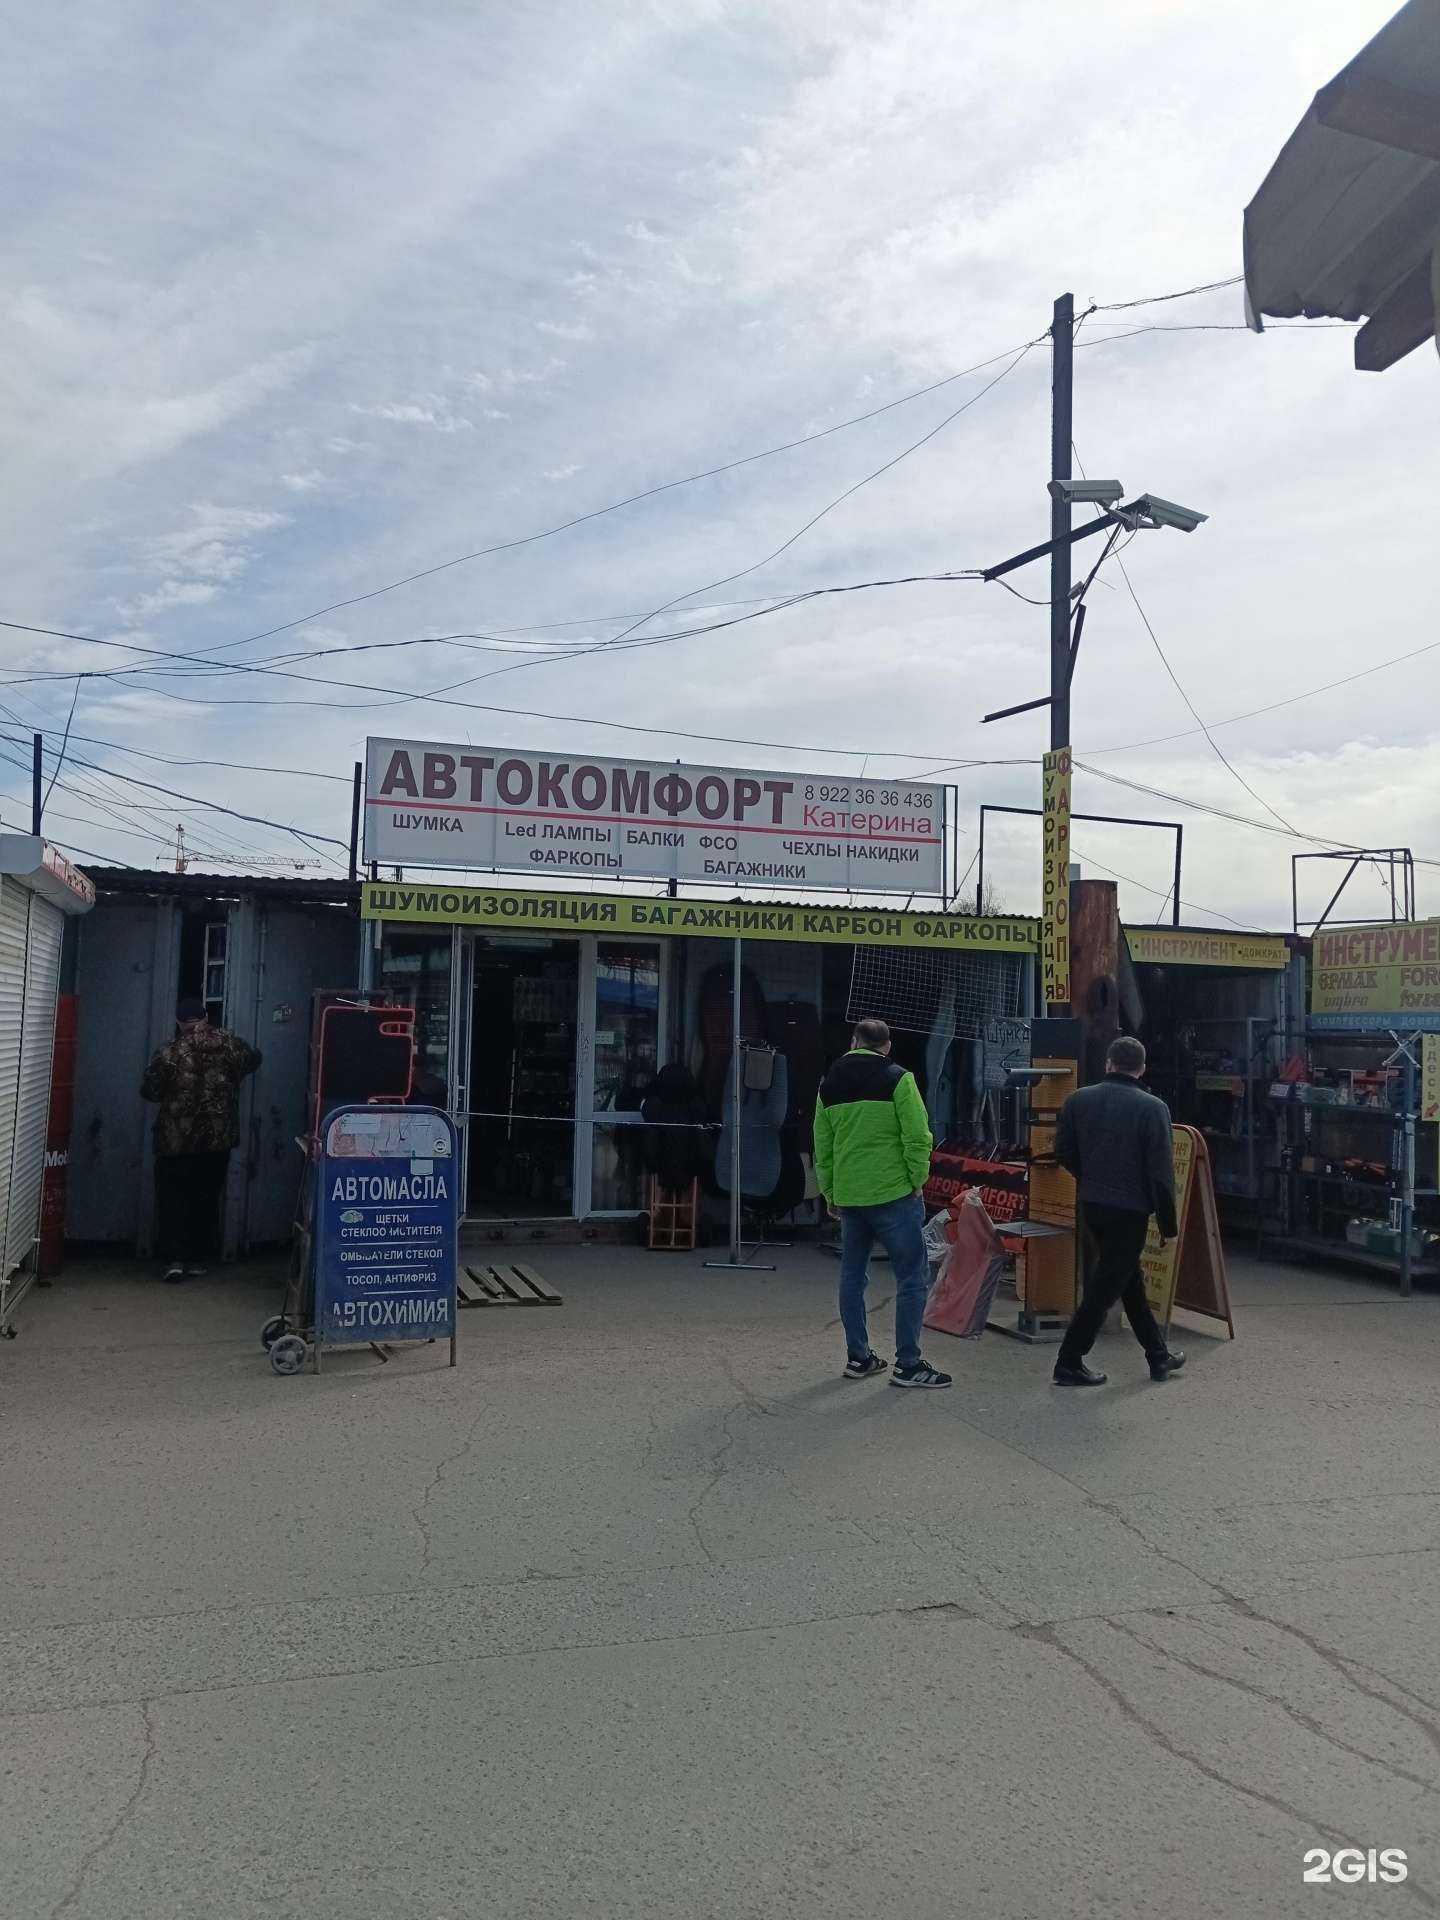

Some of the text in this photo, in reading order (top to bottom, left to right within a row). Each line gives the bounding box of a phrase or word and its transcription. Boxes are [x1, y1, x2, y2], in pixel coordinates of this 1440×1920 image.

[380, 750, 793, 824] АВТОКОМФОРТ
[805, 785, 933, 809] 8 922 36 36 436
[393, 813, 463, 832] ШУМКА
[803, 804, 932, 835] Катерина
[505, 822, 737, 850] Led ЛАМПЫ БАЛКИ ФСО
[530, 849, 806, 879] ФАРКОПЫ БАГАЖНИКИ
[783, 841, 919, 863] ЧЕХЛЫ НАКИДКИ
[1043, 754, 1057, 1000] ШУМОИЗОЛЯЦИЯ
[1056, 752, 1070, 1000] ФАРКОПЫ
[369, 890, 1035, 943] ШУМОИЗОЛЯЦИЯ БАГАЖНИКИ КАРБОН ФАРКОПЫ
[1139, 936, 1238, 961] ИНСТРУМЕНТ
[1319, 926, 1440, 967] ИНСТРУМЕ
[1400, 967, 1440, 987] FOR
[332, 1176, 448, 1201] АВТОМАСЛА
[375, 1214, 409, 1226] ЩЕТКИ
[405, 1249, 443, 1260] СТЕКОЛ
[384, 1272, 437, 1284] АНТИФРИЗ
